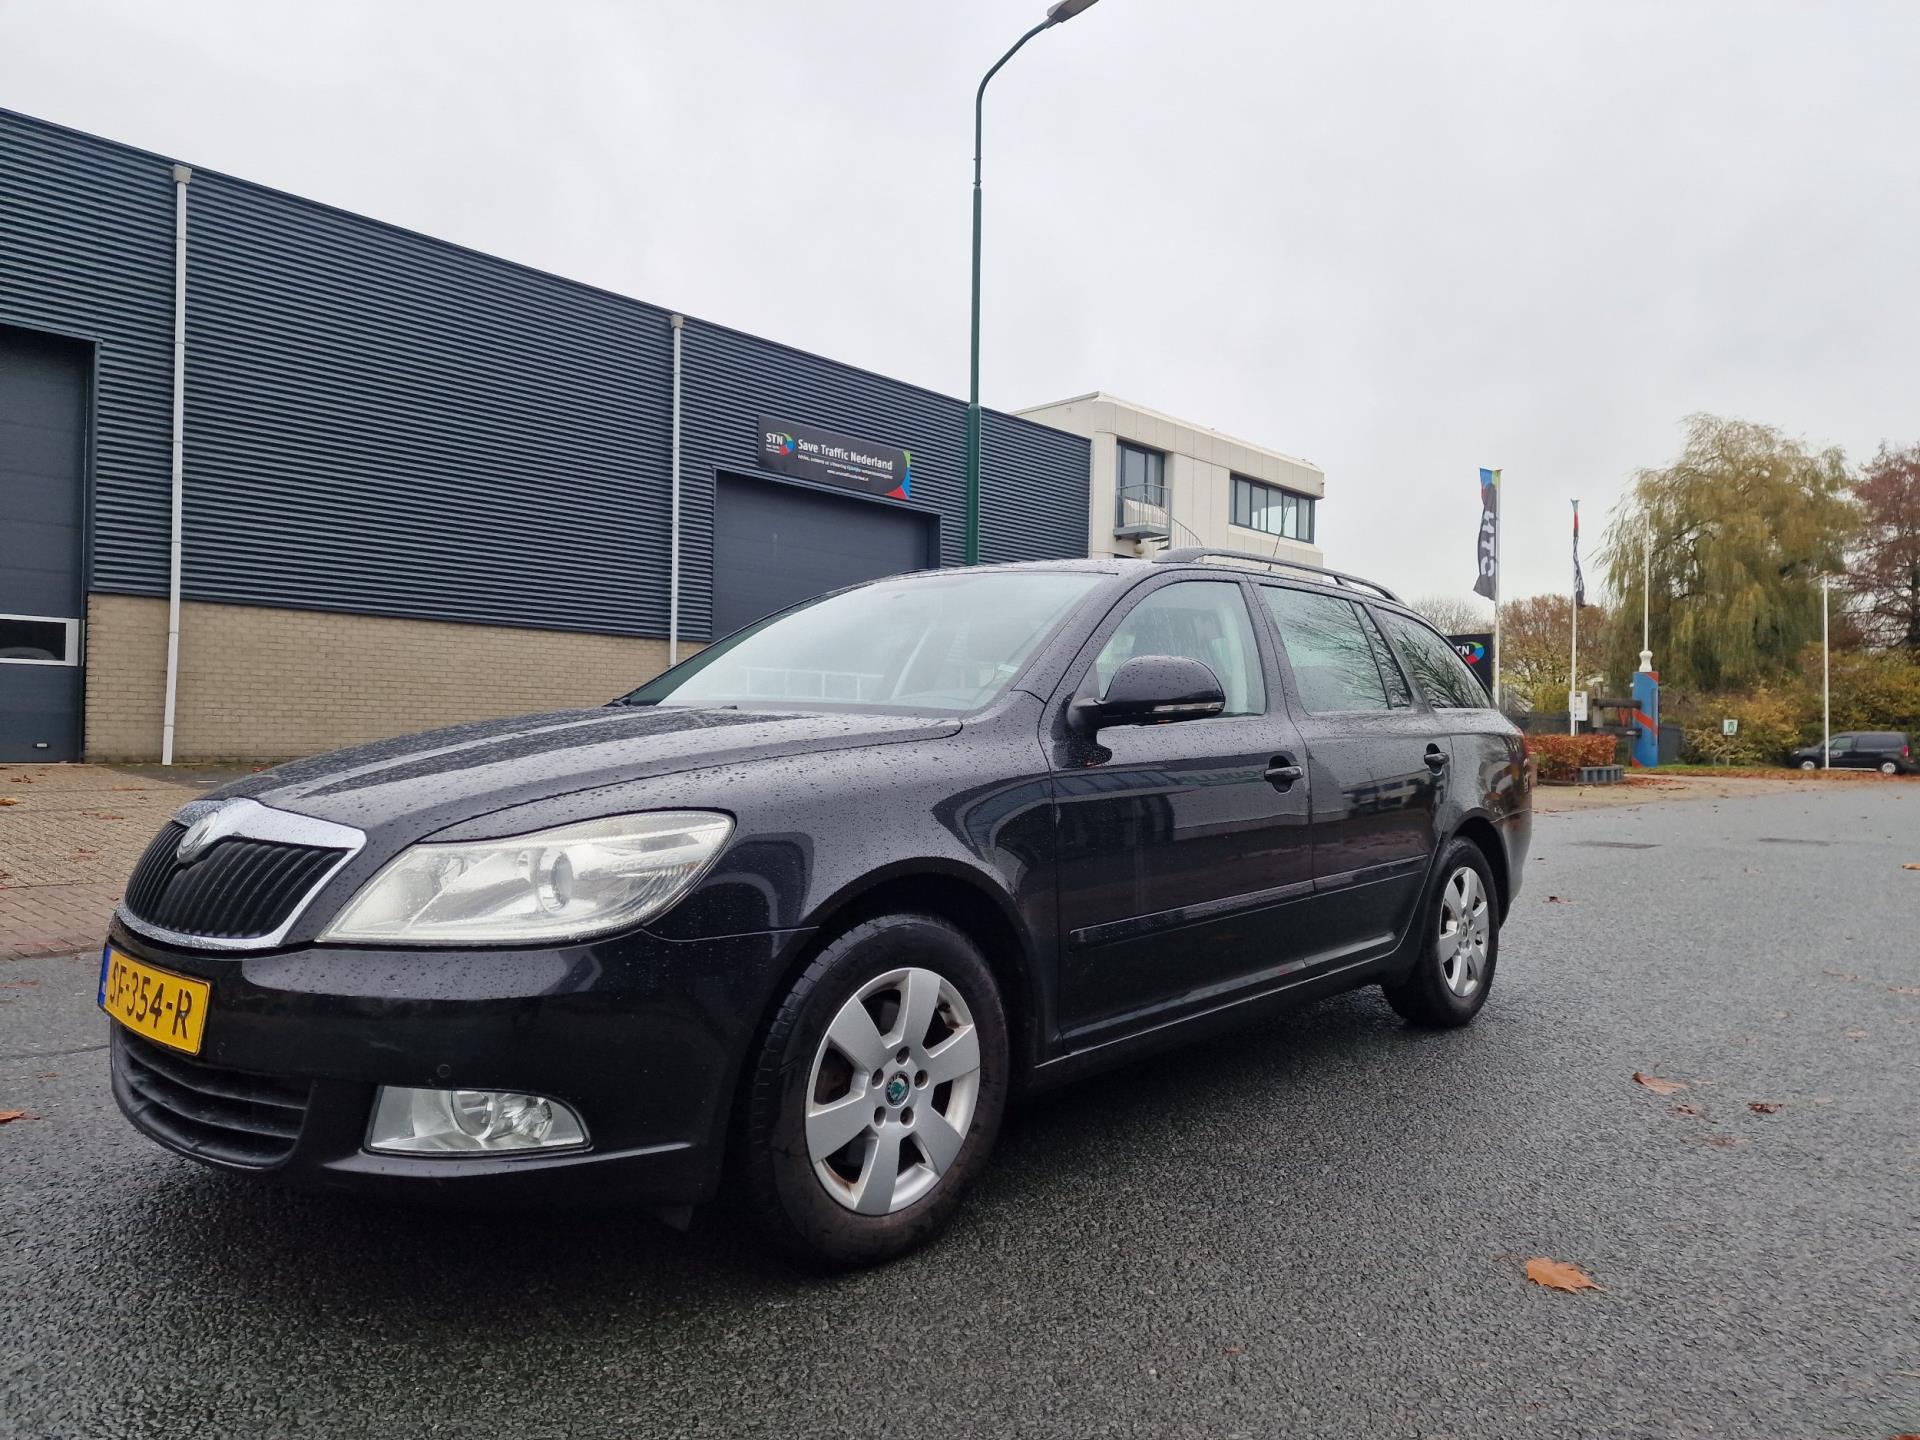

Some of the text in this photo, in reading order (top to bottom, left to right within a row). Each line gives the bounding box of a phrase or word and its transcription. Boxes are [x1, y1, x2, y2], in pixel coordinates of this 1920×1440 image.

[766, 433, 783, 445] STN
[798, 439, 819, 453] Save
[821, 444, 849, 460] Traffic
[850, 451, 893, 470] Nederland
[109, 960, 192, 1039] SF-354-R
